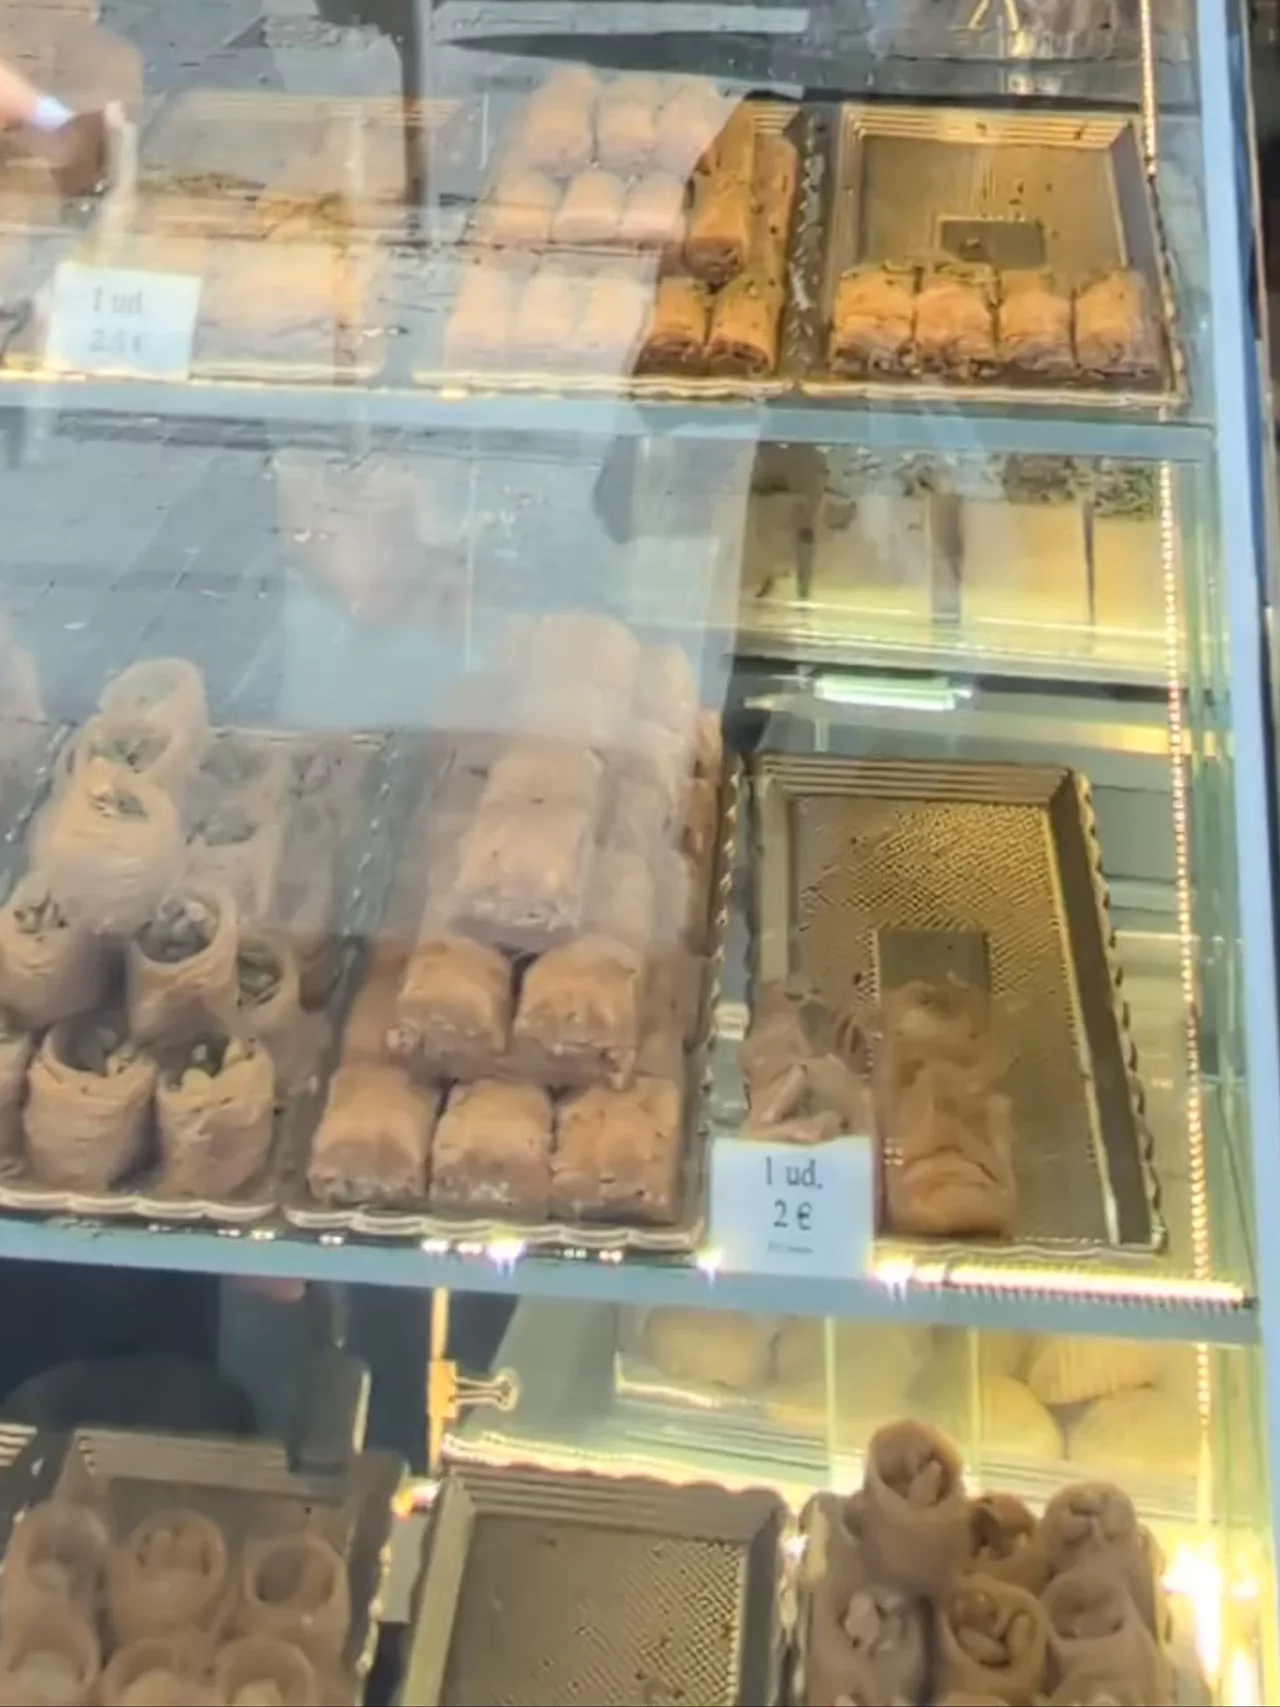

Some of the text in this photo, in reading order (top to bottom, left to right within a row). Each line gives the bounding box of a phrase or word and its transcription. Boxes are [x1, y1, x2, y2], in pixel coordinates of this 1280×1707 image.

[765, 1155, 823, 1190] 1 ud.
[773, 1198, 813, 1231] 2 €
